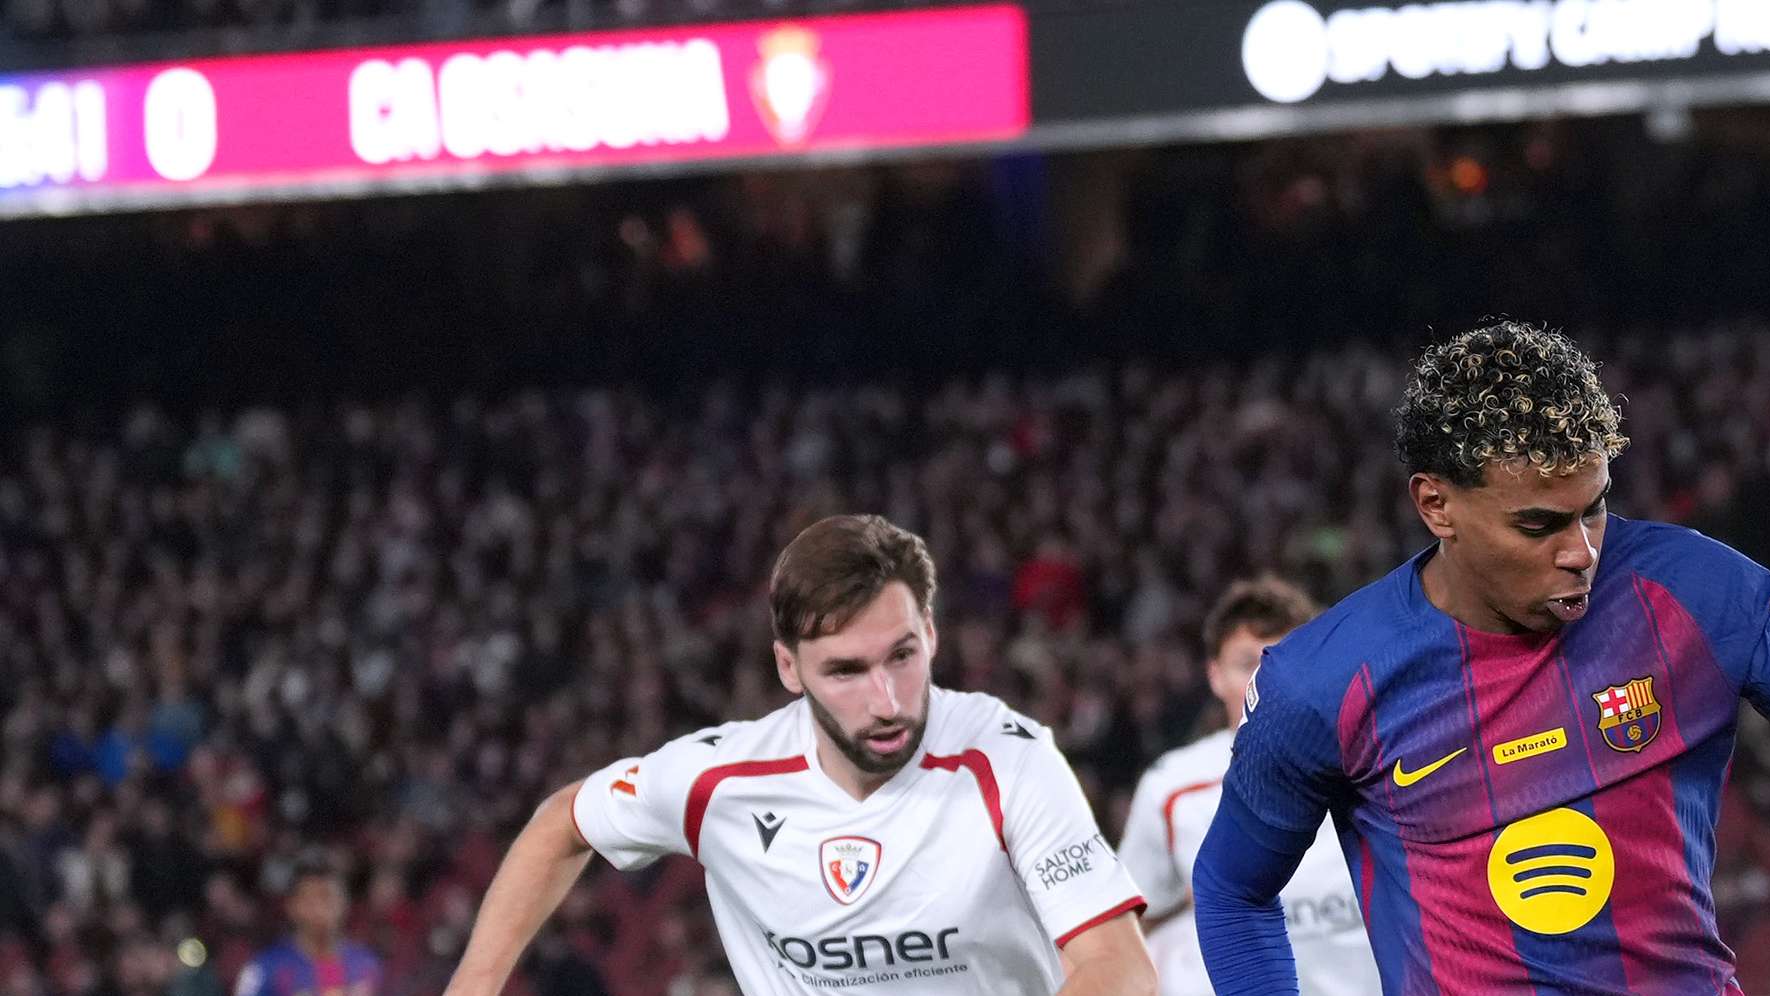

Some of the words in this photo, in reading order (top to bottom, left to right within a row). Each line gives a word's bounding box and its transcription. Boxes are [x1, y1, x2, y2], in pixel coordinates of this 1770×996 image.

[144, 67, 217, 181] 0
[1502, 749, 1515, 757] La
[1517, 735, 1558, 753] Marató
[1035, 839, 1095, 877] SALTOK
[1041, 857, 1092, 891] HOME
[904, 964, 969, 980] eficiente
